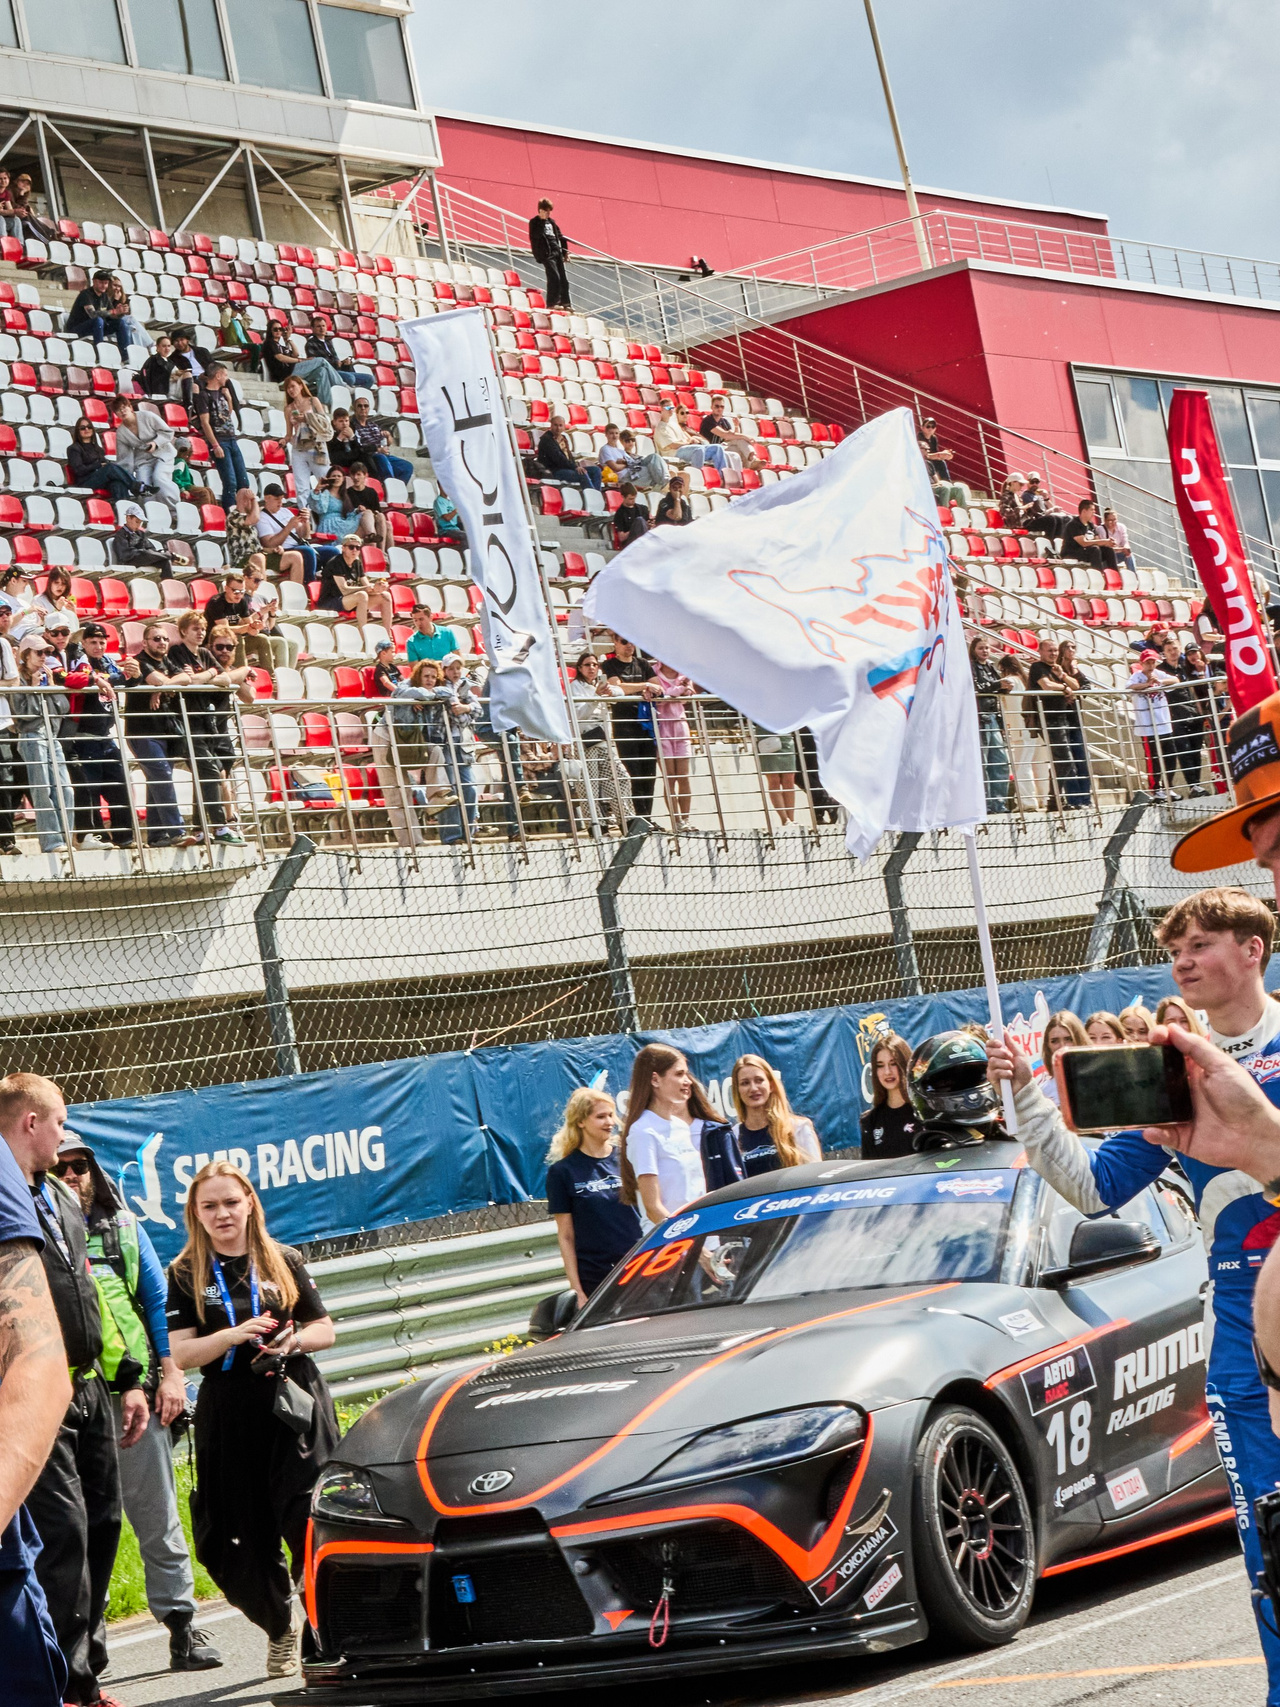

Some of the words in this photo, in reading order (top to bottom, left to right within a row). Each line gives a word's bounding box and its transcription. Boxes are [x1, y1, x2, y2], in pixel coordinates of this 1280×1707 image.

[1222, 1038, 1254, 1054] HRX
[257, 1126, 385, 1190] RACING
[761, 1195, 812, 1213] SMP
[813, 1187, 897, 1205] RACING
[618, 1239, 695, 1286] 18
[1217, 1260, 1241, 1271] HRX
[1113, 1321, 1207, 1401] RUMO
[475, 1380, 638, 1409] RUMOS
[1106, 1383, 1177, 1435] RACING
[1046, 1400, 1091, 1475] 18
[1061, 1484, 1077, 1502] SMP
[1074, 1473, 1096, 1495] RACING
[1208, 1410, 1233, 1453] SMP
[1223, 1456, 1250, 1530] RACING
[836, 1526, 889, 1579] YOKOHAMA
[867, 1570, 899, 1604] auto.ru
